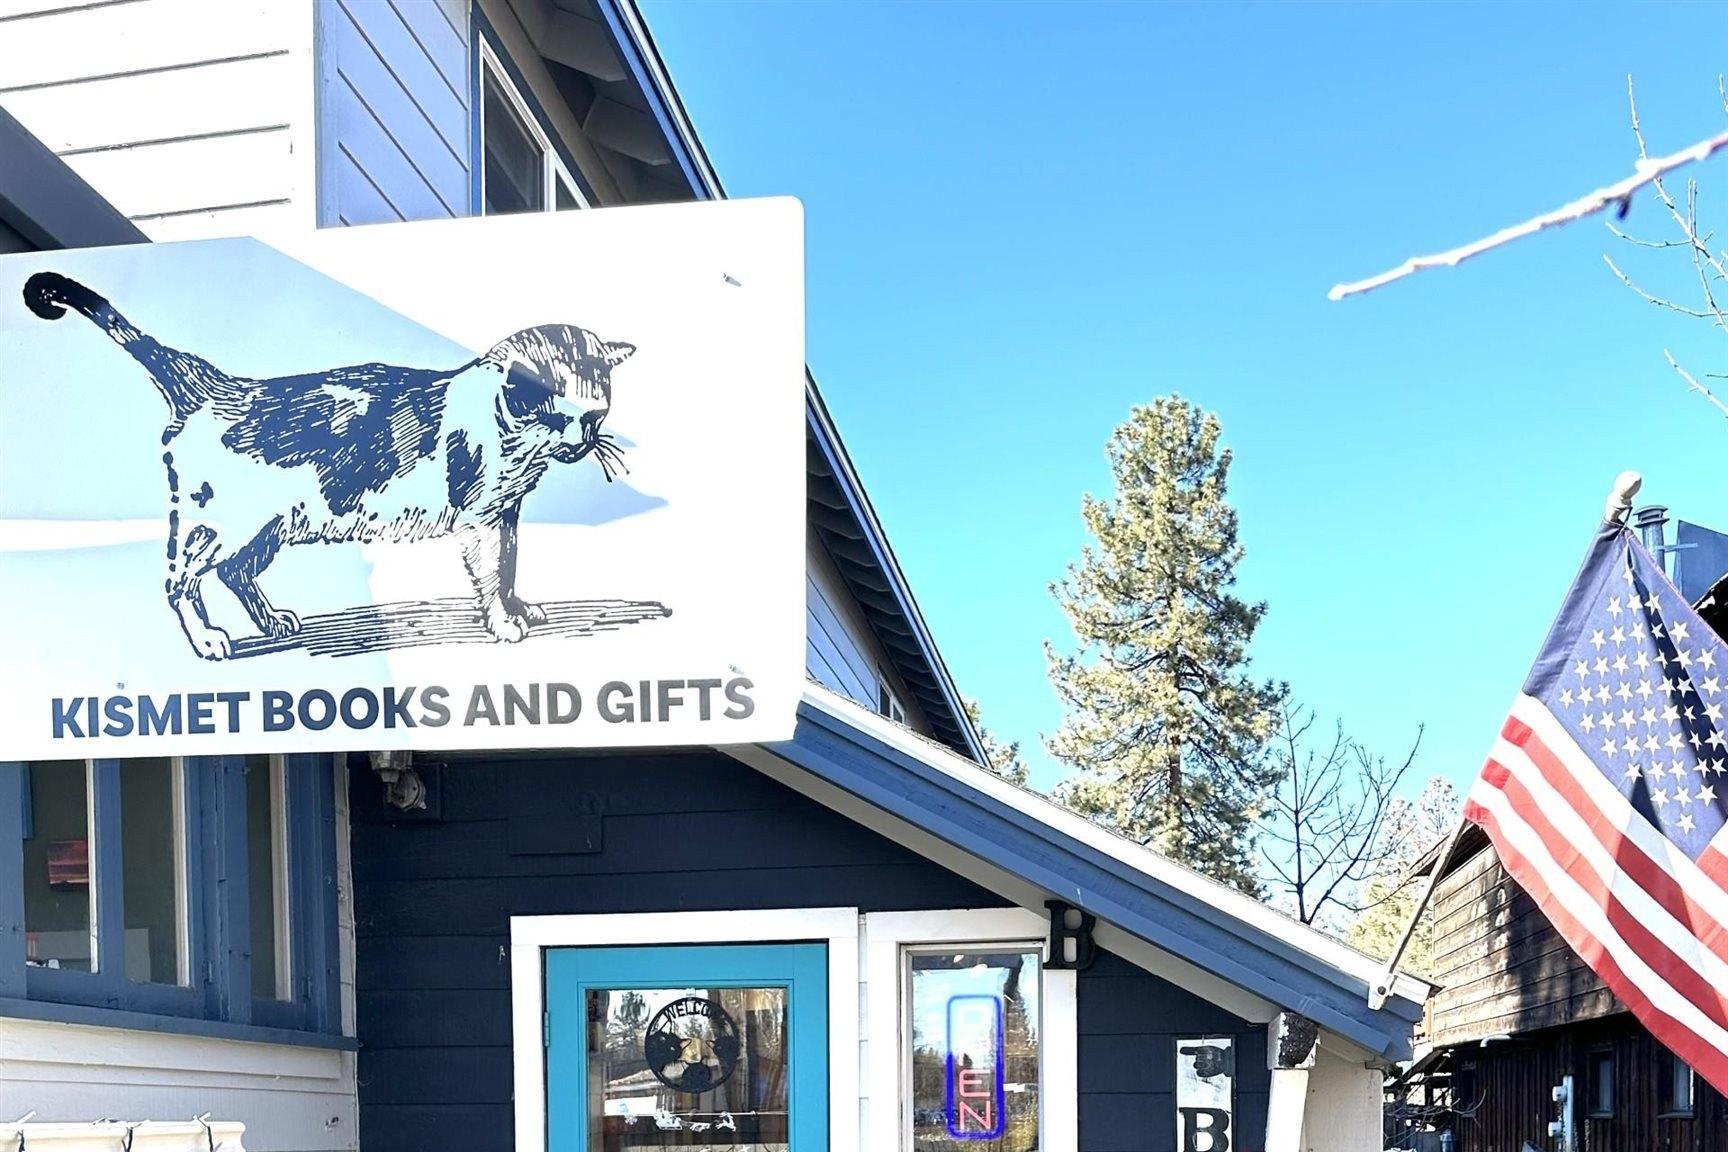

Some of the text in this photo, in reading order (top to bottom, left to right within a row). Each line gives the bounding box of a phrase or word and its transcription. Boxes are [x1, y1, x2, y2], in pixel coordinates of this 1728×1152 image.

[51, 675, 756, 739] KISMET BOOKS AND GIFTS
[1043, 900, 1096, 970] B
[663, 1000, 724, 1021] WELCO
